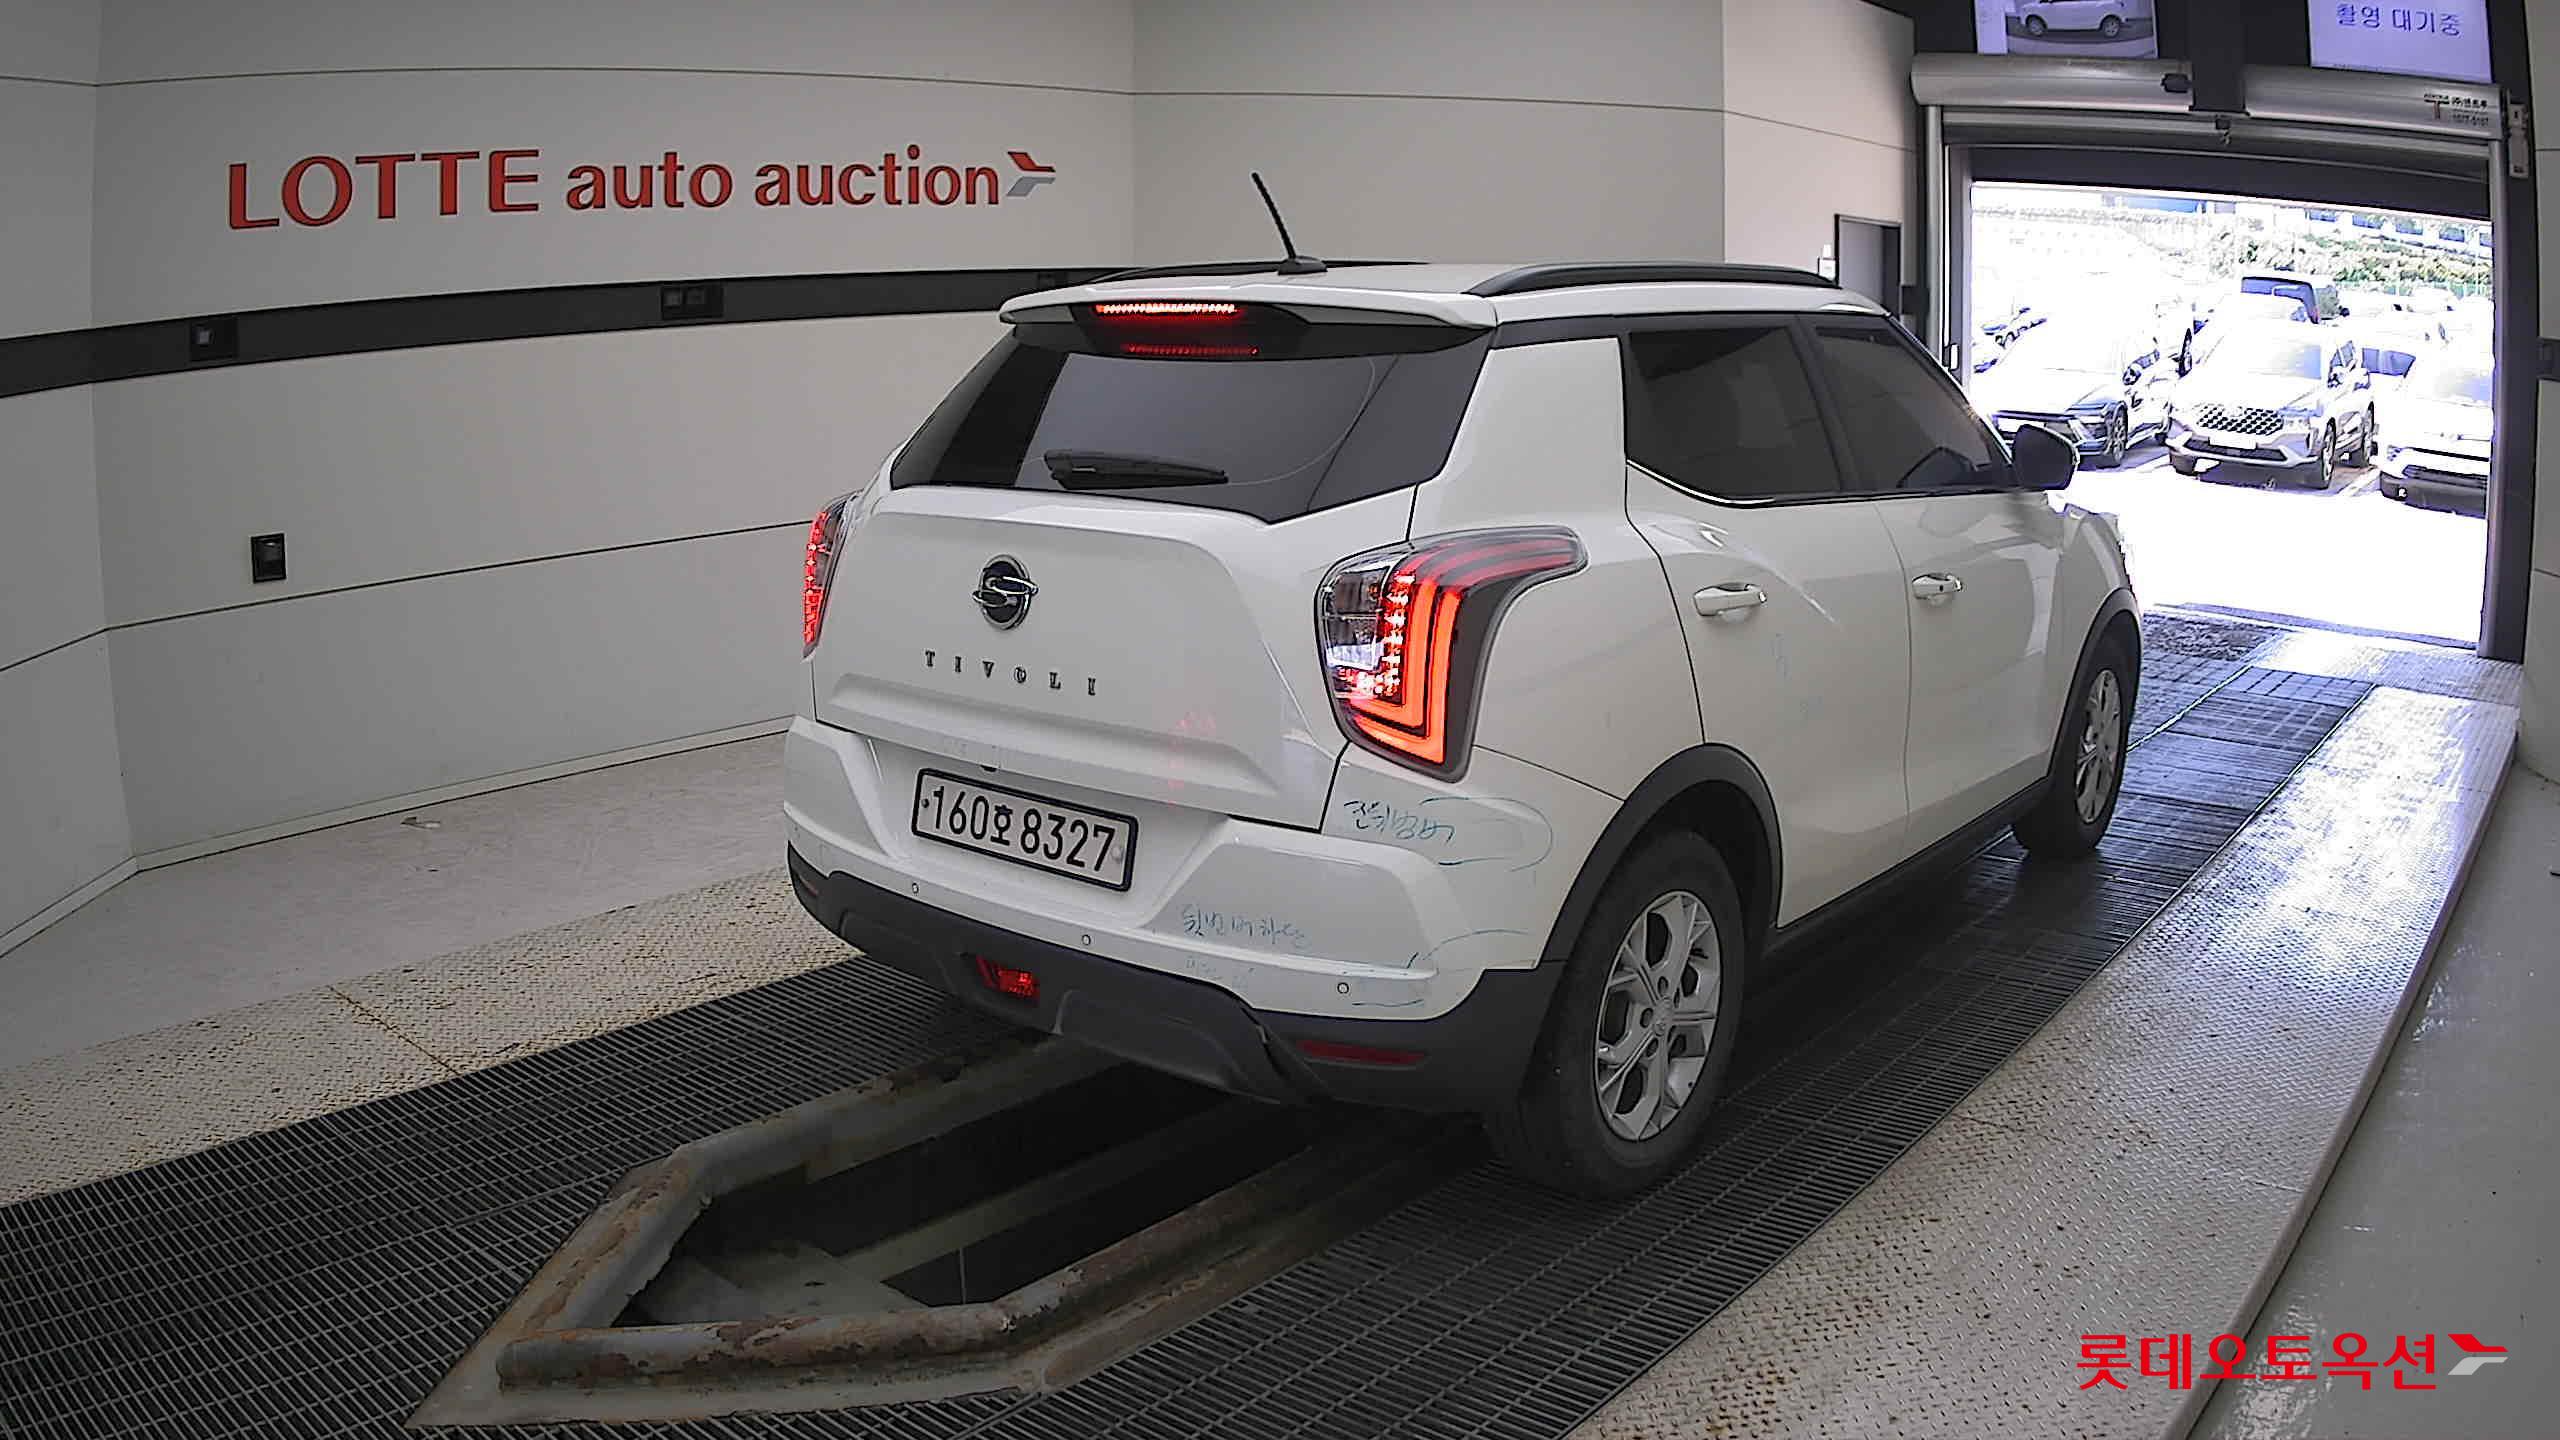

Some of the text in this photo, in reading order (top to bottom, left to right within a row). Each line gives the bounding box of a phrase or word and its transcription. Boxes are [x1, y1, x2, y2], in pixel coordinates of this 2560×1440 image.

[2337, 3, 2461, 37] 촬영 대기중
[228, 143, 1000, 230] LOTTE auto auction
[924, 649, 1097, 697] TIVOLI
